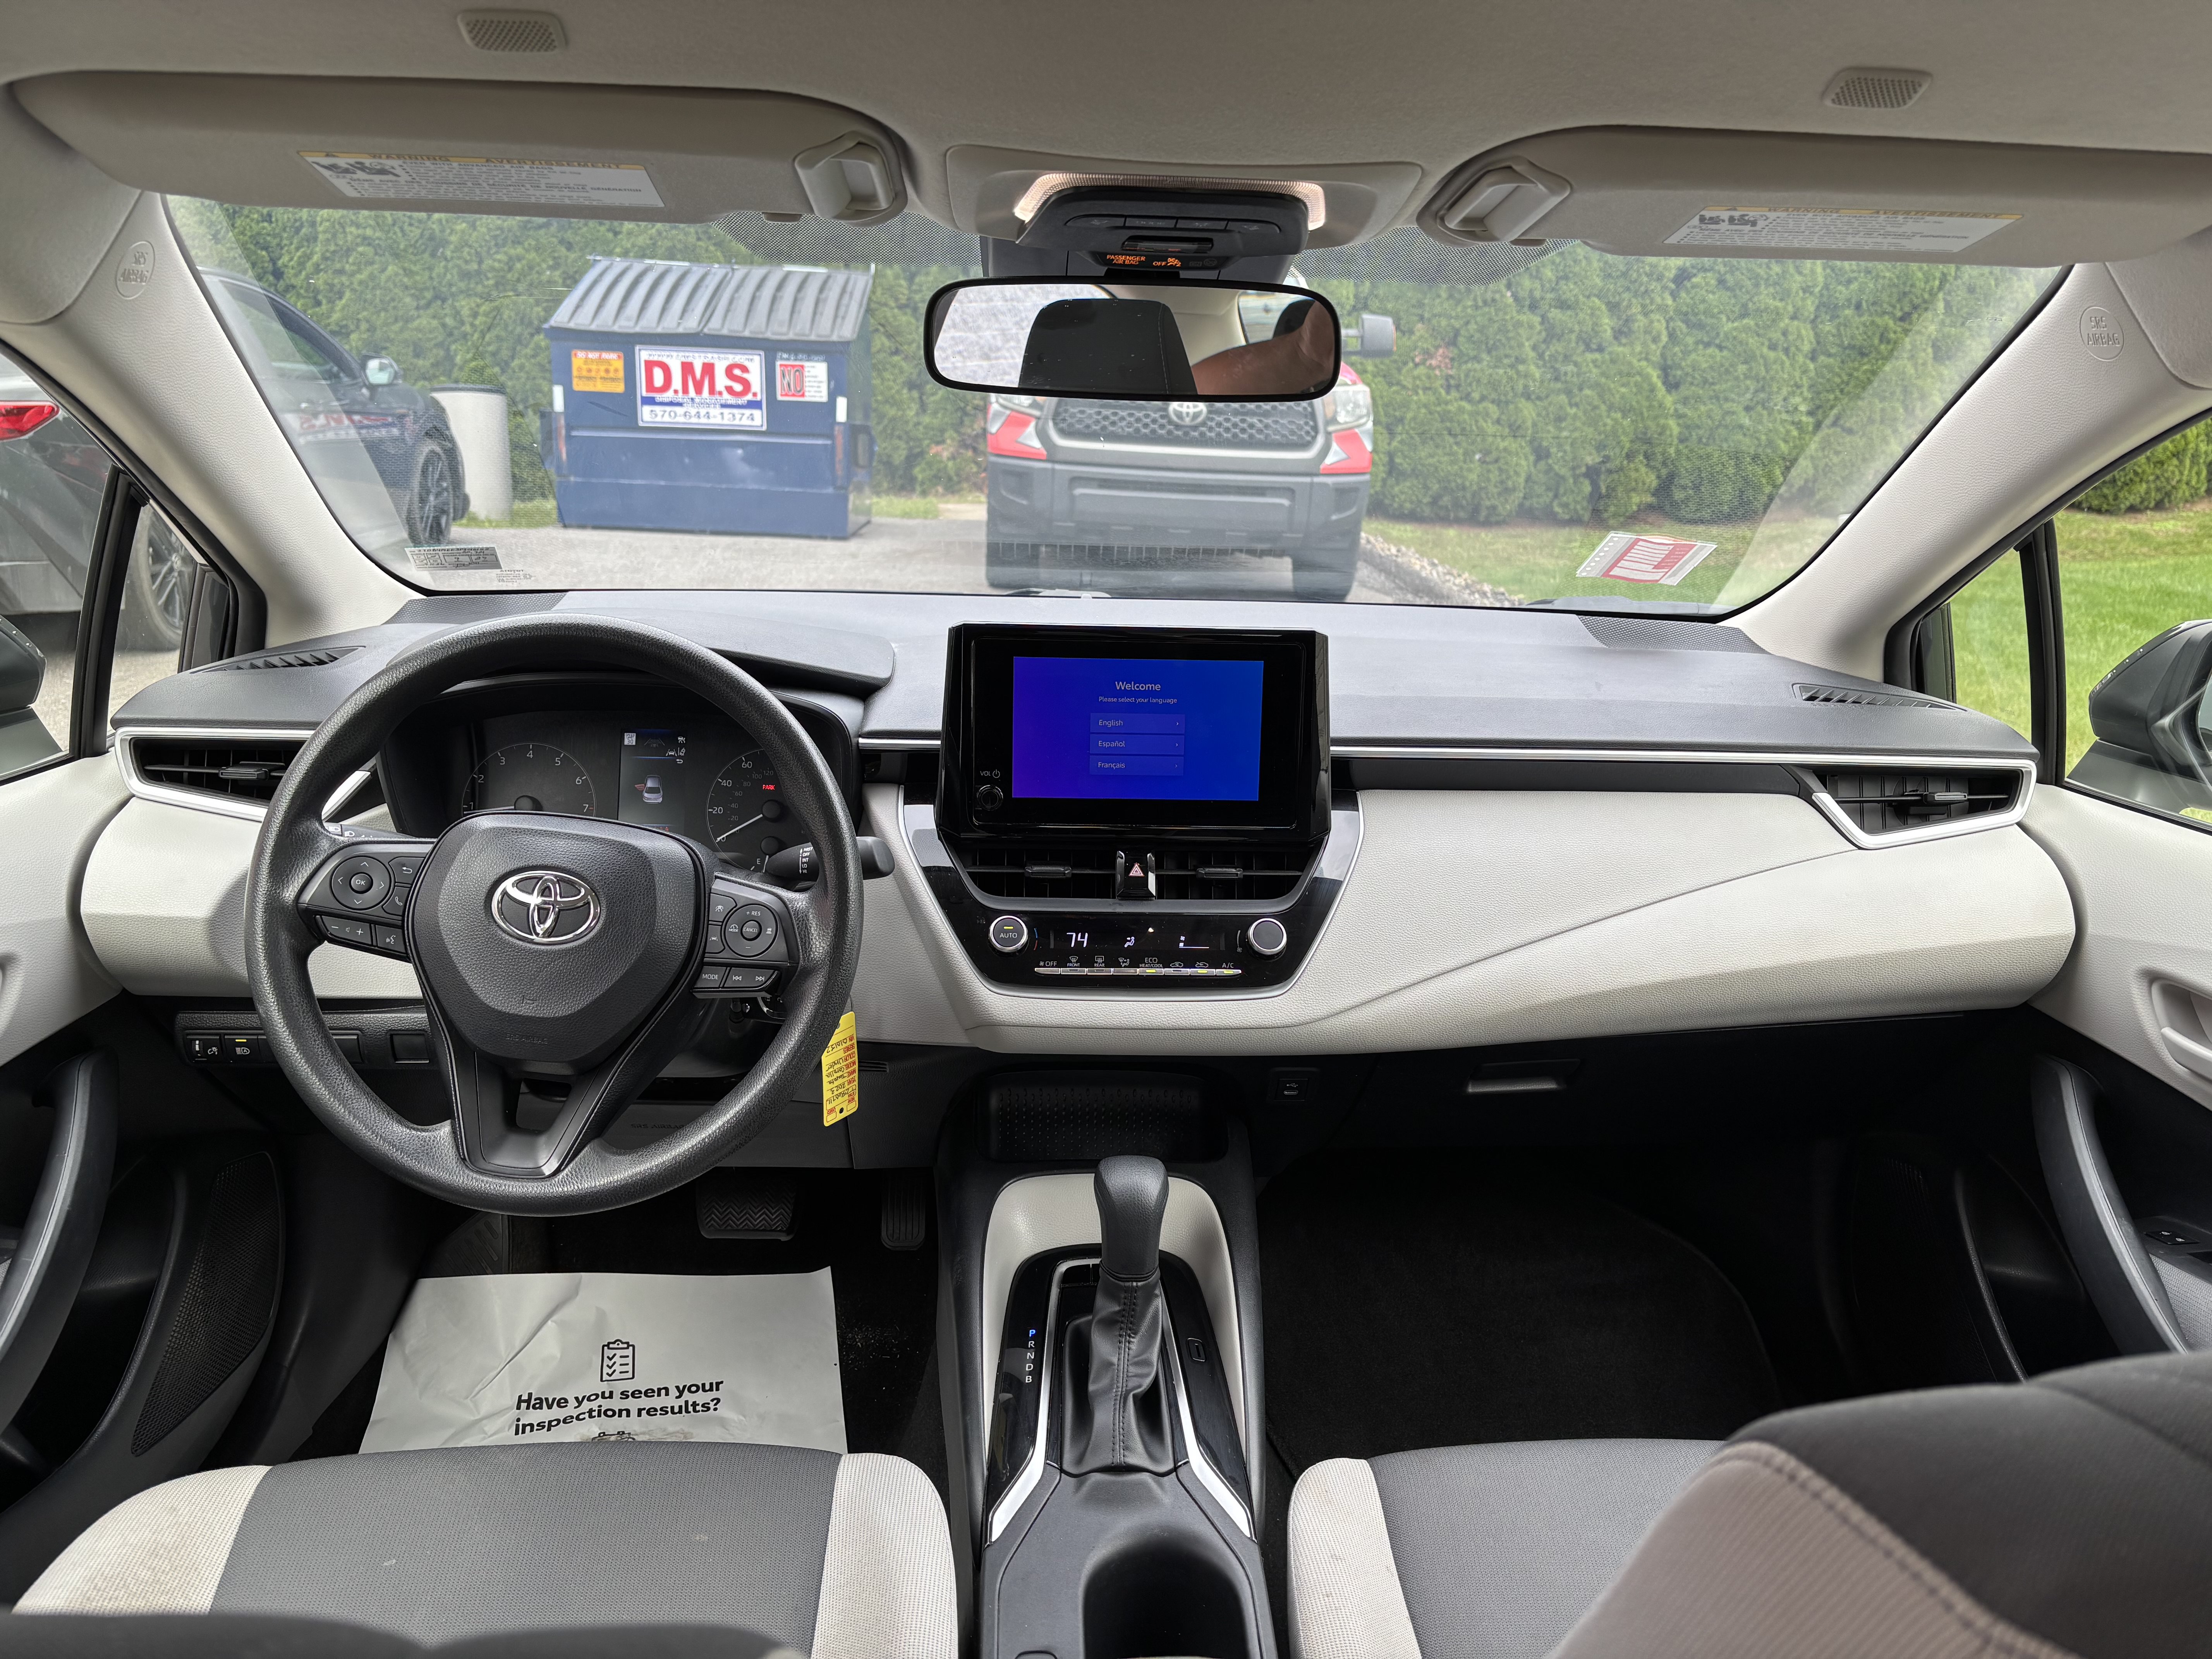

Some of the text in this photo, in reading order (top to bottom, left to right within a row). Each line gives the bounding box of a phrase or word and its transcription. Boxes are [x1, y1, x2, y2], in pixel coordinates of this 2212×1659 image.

[2090, 316, 2107, 330] SRS
[2087, 333, 2121, 347] AIRBAG
[644, 360, 758, 398] D.M.S.
[781, 367, 804, 394] NO
[649, 409, 756, 422] 570-644-1374
[1115, 682, 1161, 690] Welcome
[555, 757, 561, 766] 5
[1098, 762, 1125, 770] Français
[575, 776, 582, 785] 6
[1066, 933, 1088, 947] 74
[843, 1043, 855, 1054] SERIES
[844, 1052, 855, 1062] COLOR
[845, 1060, 856, 1070] MODEL
[831, 1083, 846, 1094] 2023
[515, 1380, 724, 1411] Have you seen your
[514, 1397, 721, 1436] inspection results?
